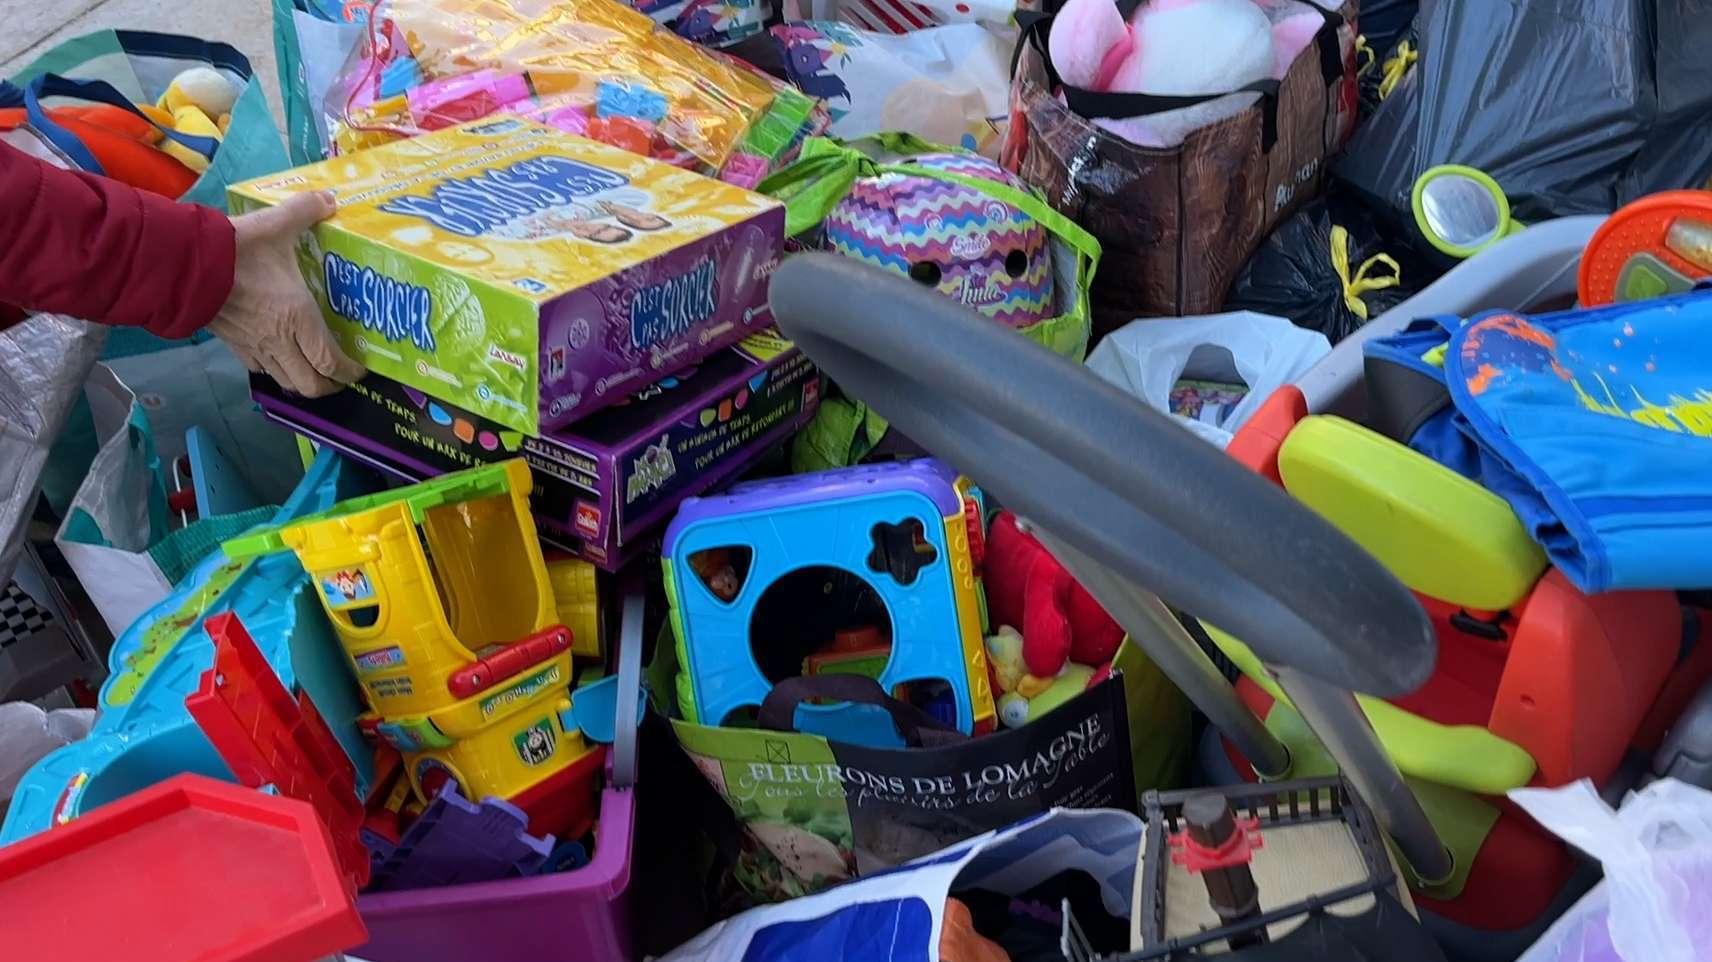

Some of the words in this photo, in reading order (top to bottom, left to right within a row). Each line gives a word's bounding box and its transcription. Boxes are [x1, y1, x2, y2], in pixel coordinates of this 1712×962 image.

[361, 267, 435, 352] SORCIER
[660, 258, 716, 341] SORCIER
[747, 763, 906, 796] FLEURONS
[914, 775, 956, 796] DE
[965, 713, 1101, 790] LOMAGNE
